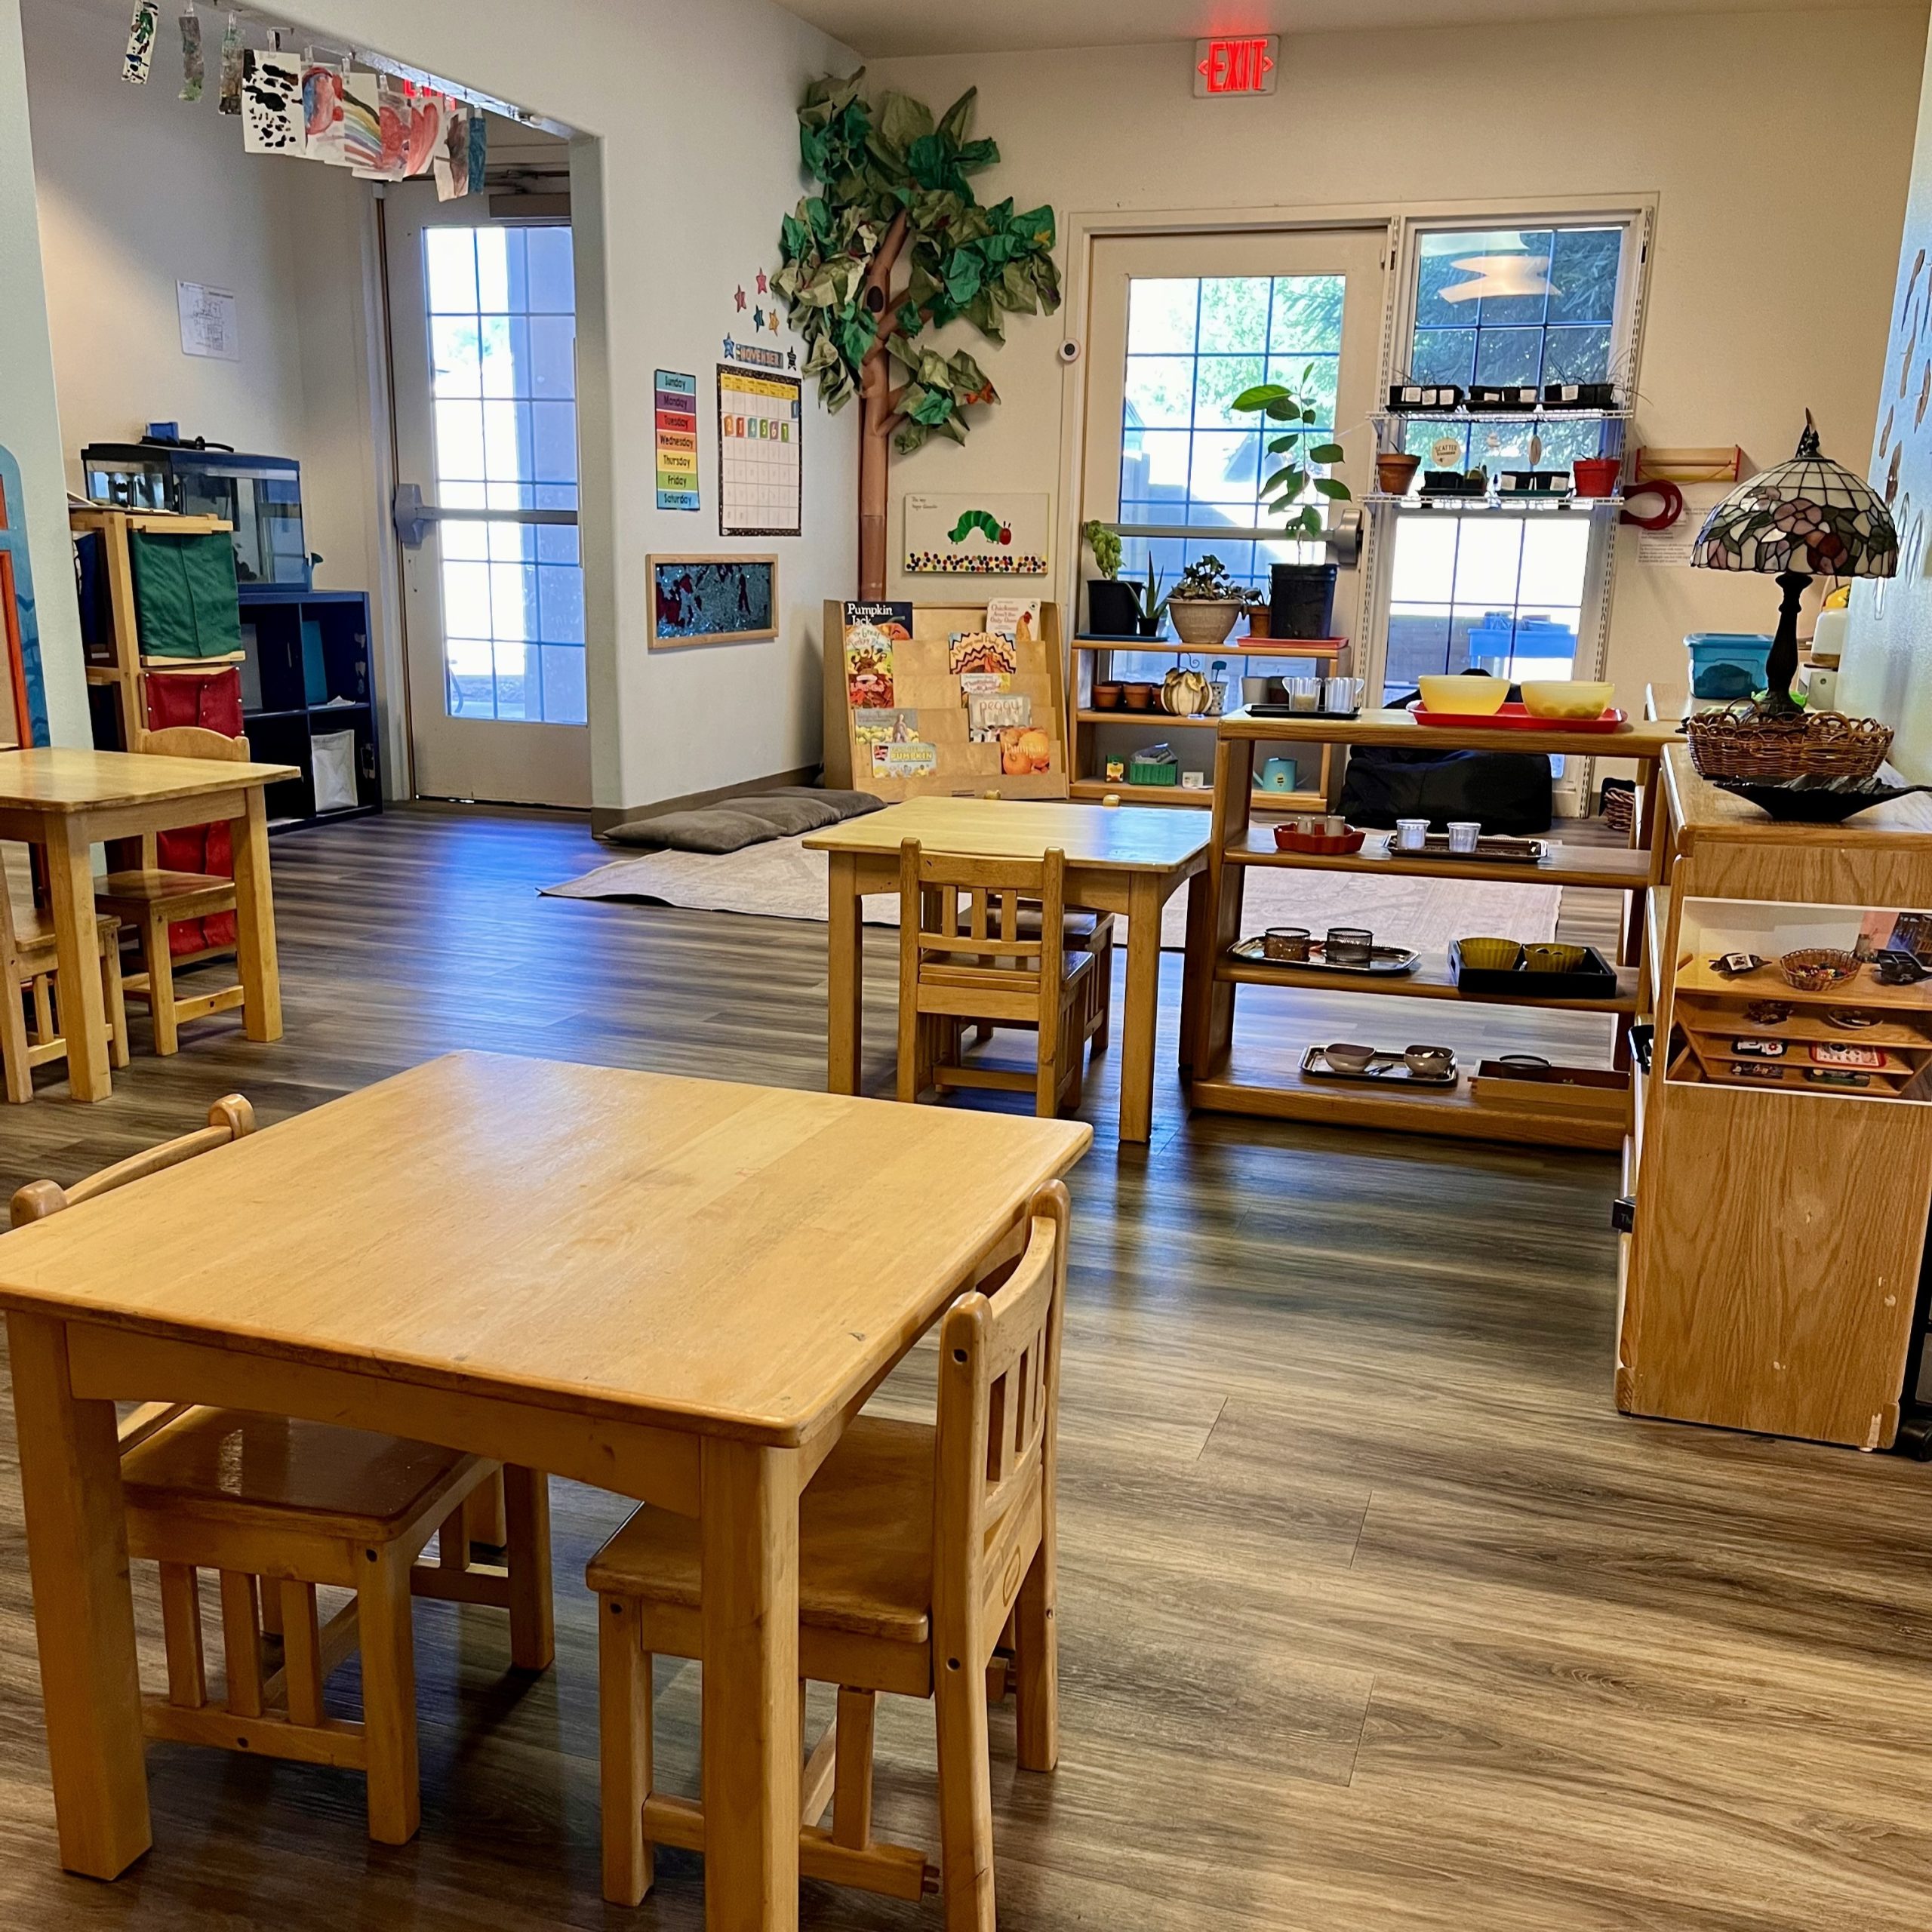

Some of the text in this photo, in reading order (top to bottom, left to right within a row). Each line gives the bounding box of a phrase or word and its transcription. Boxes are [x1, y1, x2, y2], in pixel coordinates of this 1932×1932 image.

[1208, 39, 1268, 92] EXIT
[740, 347, 780, 366] NOVEMBER
[665, 375, 686, 391] Sunday
[663, 395, 688, 411] Monday
[664, 415, 689, 429] Tuesday
[660, 434, 694, 449] Wednesday
[663, 454, 691, 469] Thursday
[667, 475, 688, 488] Friday
[663, 493, 692, 507] Saturday
[847, 603, 894, 617] Pumpkin
[851, 615, 873, 626] Jack
[862, 628, 880, 640] Great
[980, 700, 1020, 715] peggy
[891, 752, 932, 760] PUMPKIN
[1004, 742, 1044, 756] Pumpkin
